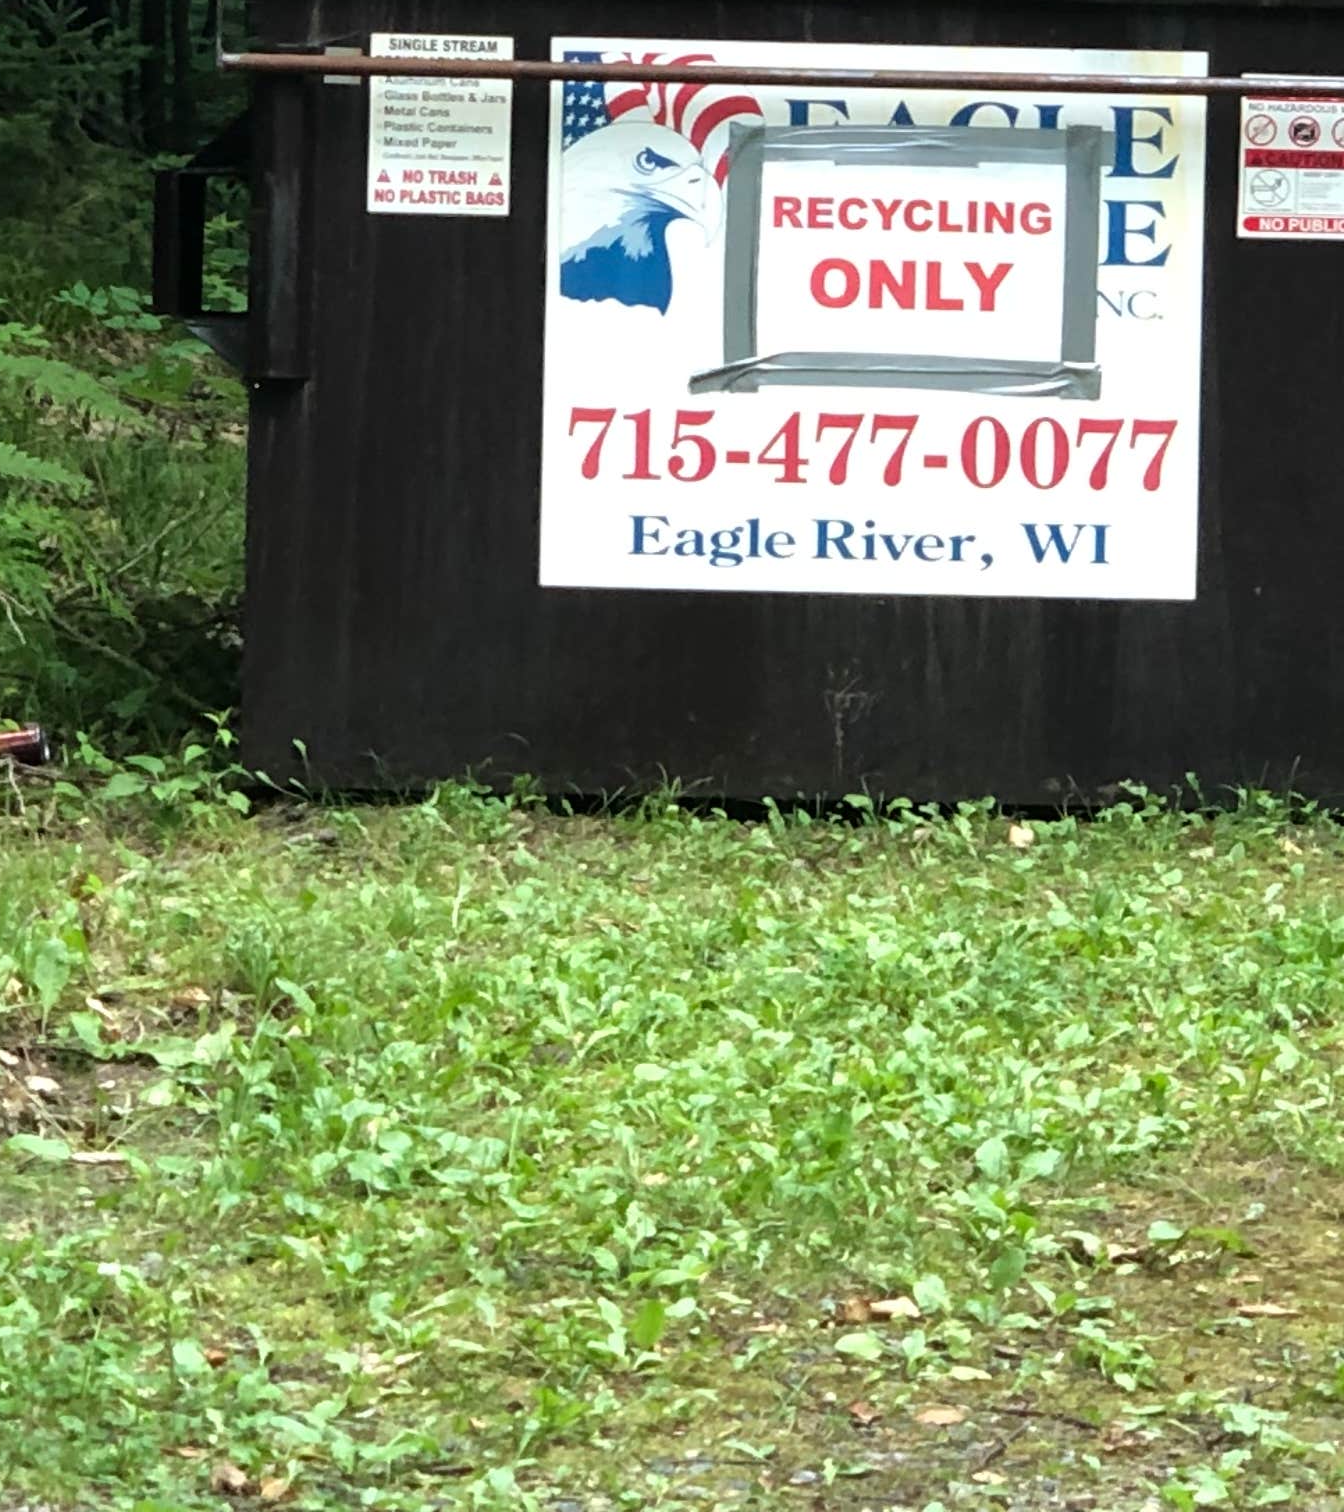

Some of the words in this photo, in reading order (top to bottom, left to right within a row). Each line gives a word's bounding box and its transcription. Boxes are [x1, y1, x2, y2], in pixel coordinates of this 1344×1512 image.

[389, 38, 438, 52] SINGLE
[443, 39, 498, 53] STREAM
[384, 90, 418, 101] Glass
[422, 90, 465, 103] Bottles
[468, 92, 477, 103] &
[481, 92, 507, 104] Jars
[384, 105, 416, 117] Metal
[419, 106, 451, 118] Cans
[1248, 102, 1265, 112] NO
[1267, 103, 1338, 114] HAZARDOUS
[383, 120, 423, 133] Plastic
[426, 122, 494, 135] Containers
[383, 137, 419, 148] Mixed
[422, 137, 458, 151] Paper
[402, 169, 424, 184] NO
[429, 170, 478, 186] TRASH
[374, 188, 396, 203] NO
[400, 189, 461, 205] PLASTIC
[466, 191, 505, 207] BAGS
[772, 195, 1053, 235] RECYCLING
[1258, 218, 1285, 232] NO
[809, 257, 1015, 313] ONLY
[1096, 290, 1164, 321] NC.
[567, 406, 1179, 492] 715-477-0077
[627, 514, 796, 569] Eagle
[810, 518, 995, 572] River,
[1021, 522, 1113, 565] WI
